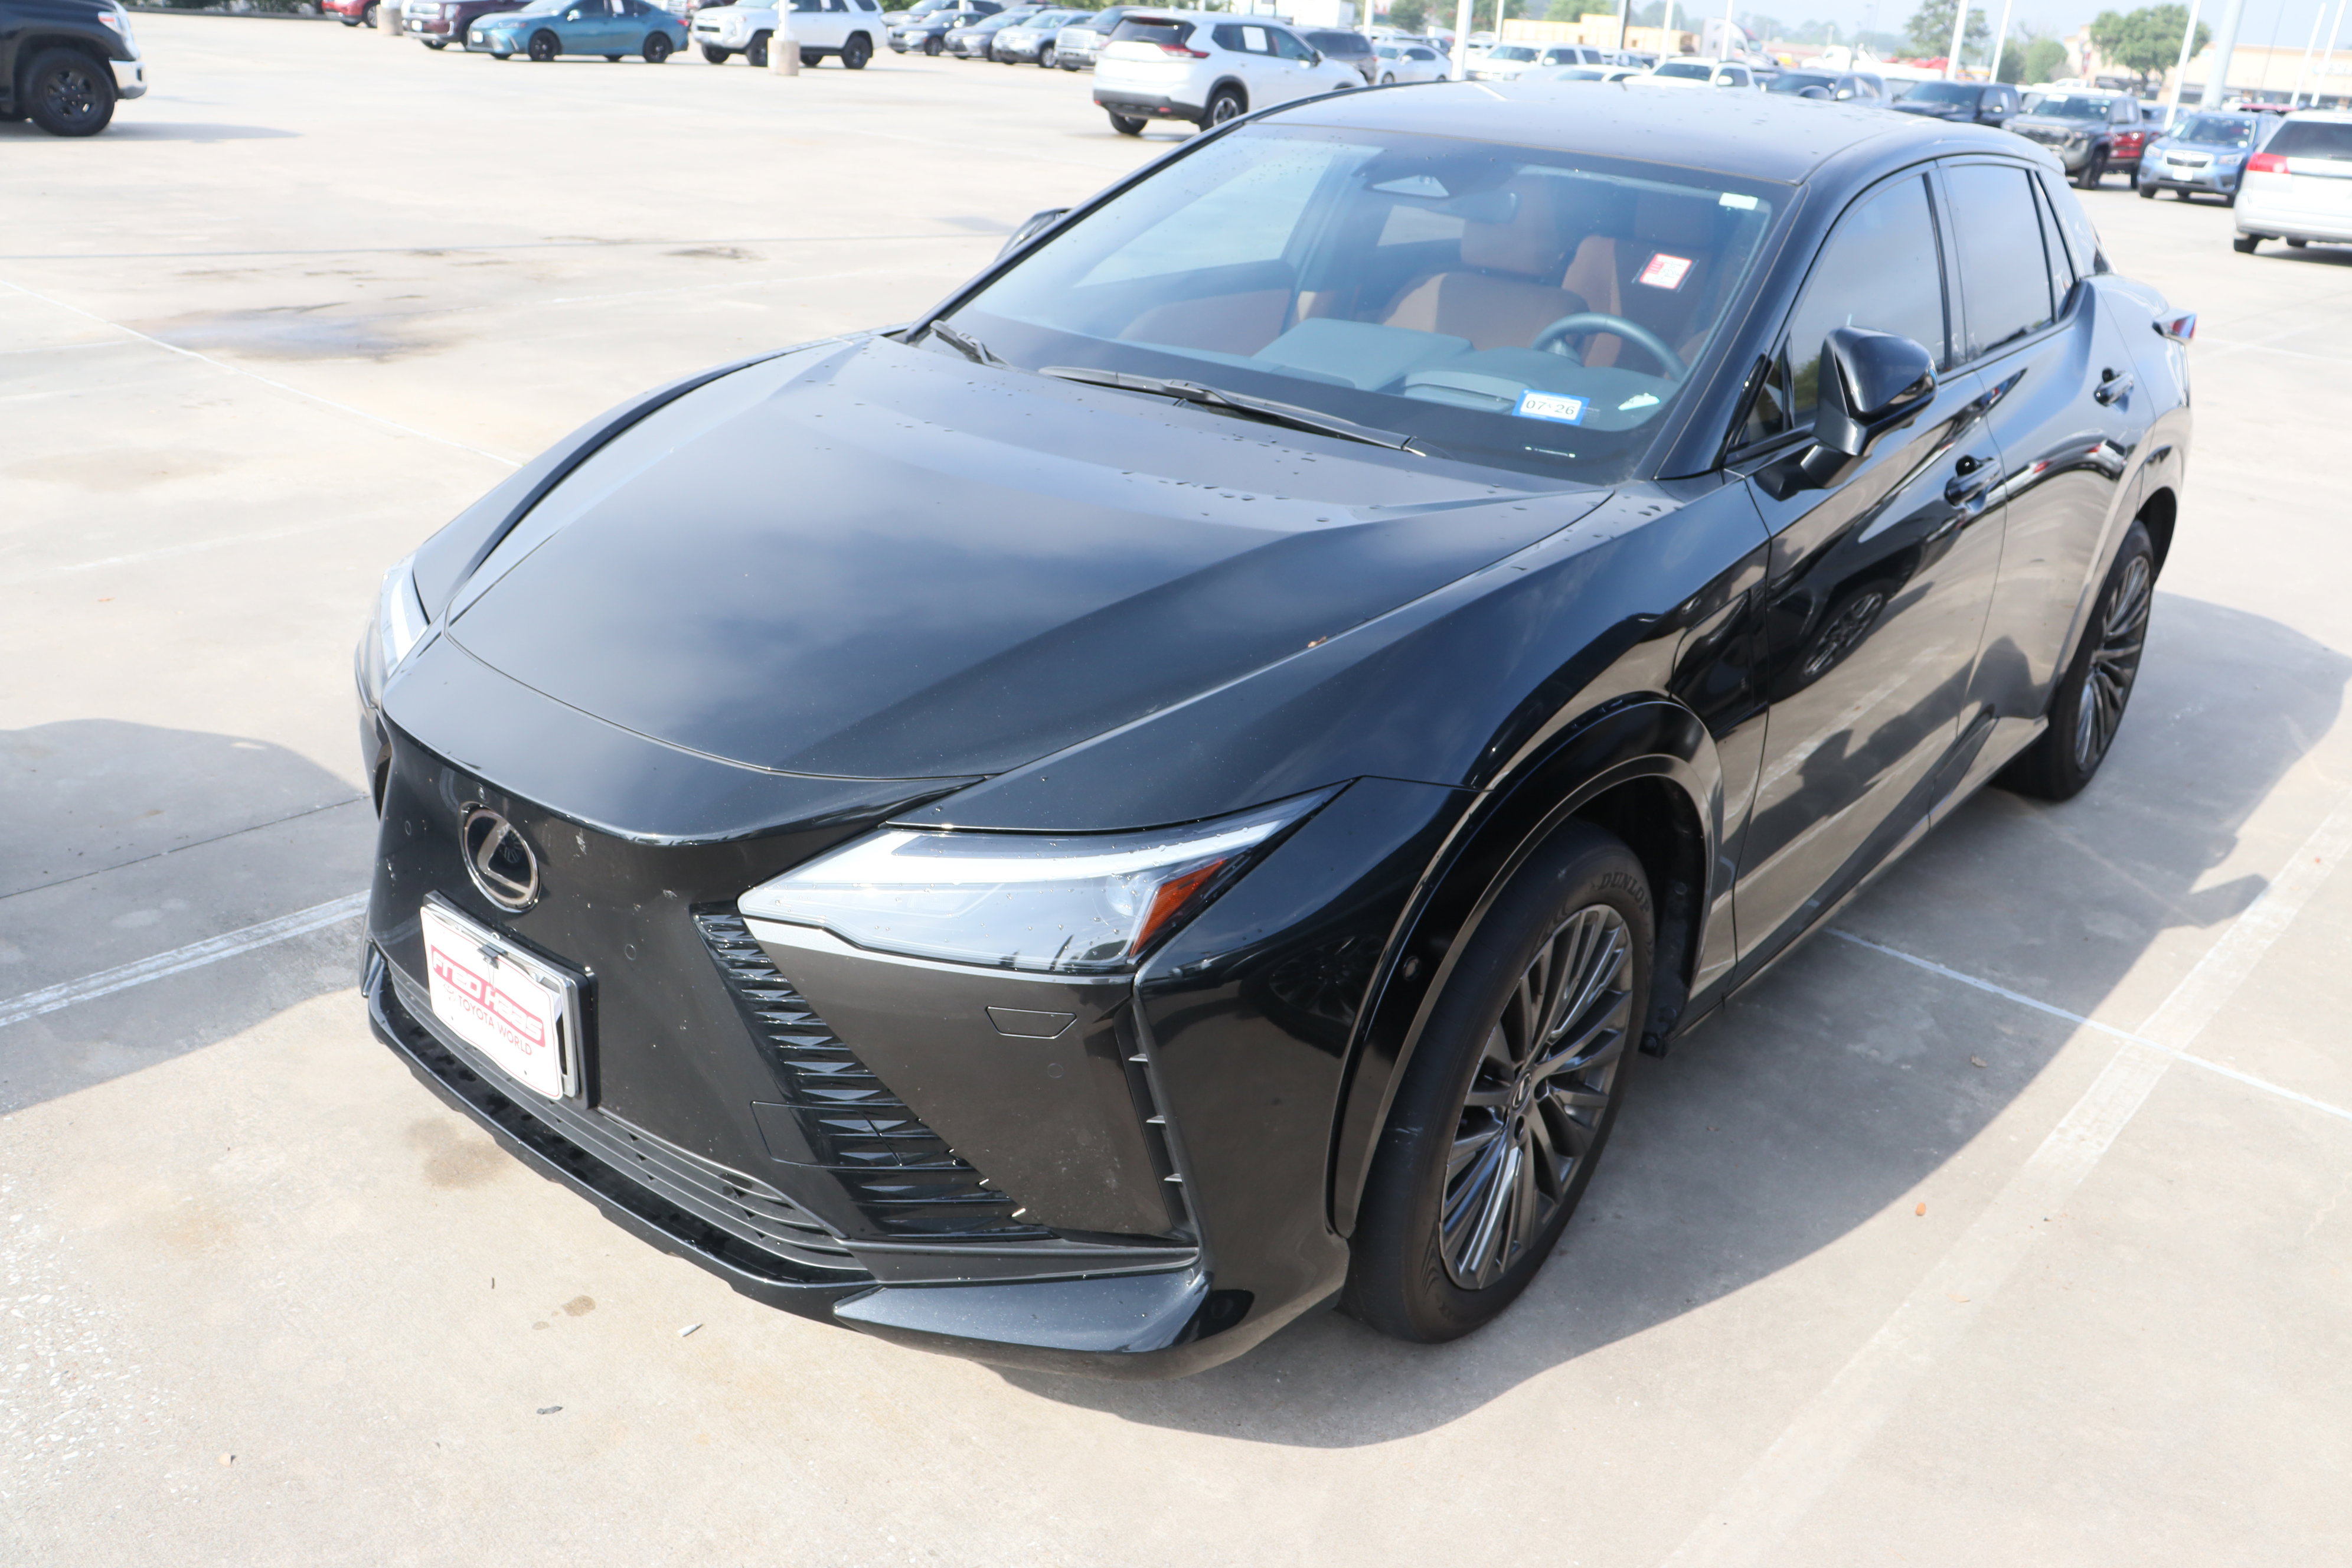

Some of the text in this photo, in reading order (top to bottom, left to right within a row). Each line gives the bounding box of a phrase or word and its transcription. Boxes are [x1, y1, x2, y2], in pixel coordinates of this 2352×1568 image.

[1525, 400, 1576, 416] 07 26
[1598, 871, 1651, 912] DUNLOP
[458, 995, 533, 1056] TOYOTA WORLD
